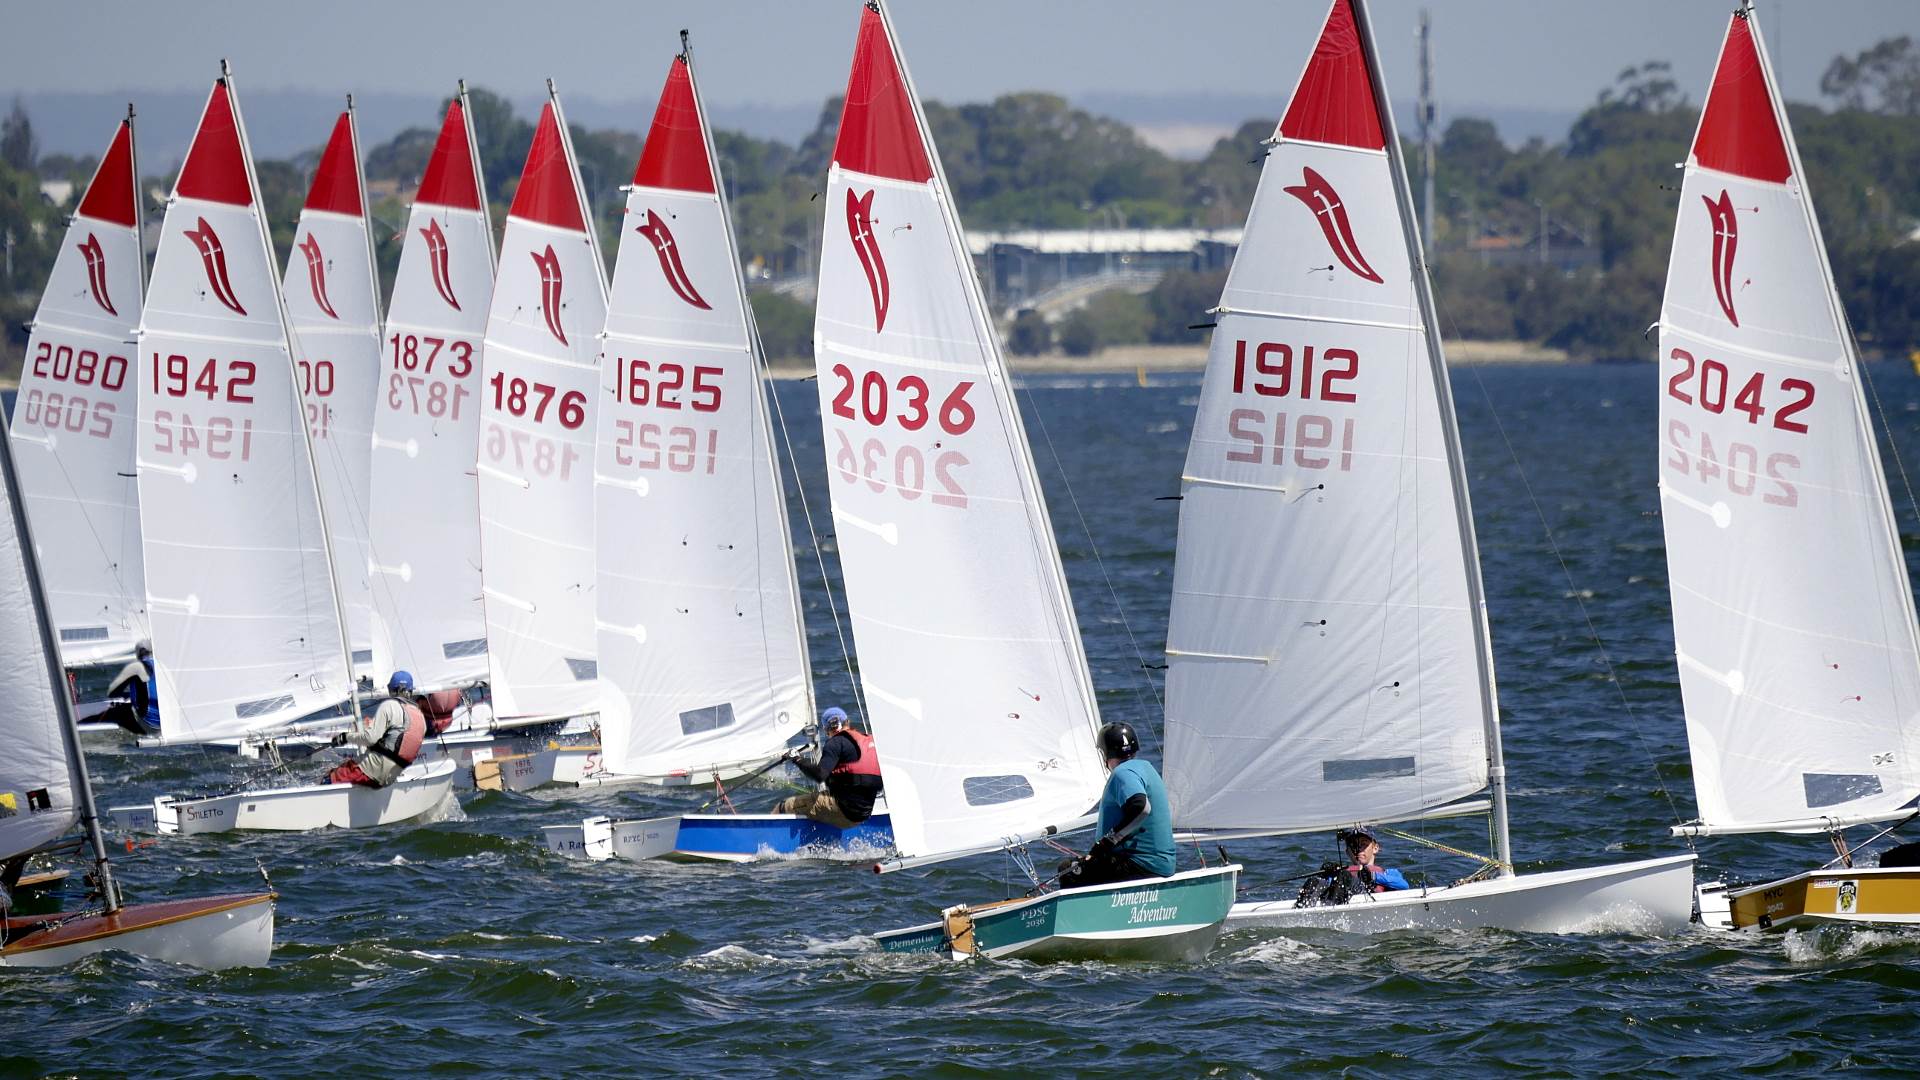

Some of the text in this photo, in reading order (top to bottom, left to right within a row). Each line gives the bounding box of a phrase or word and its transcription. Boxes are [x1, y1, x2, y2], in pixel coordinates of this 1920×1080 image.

[33, 342, 128, 392] 2080
[152, 352, 256, 404] 1942
[390, 333, 473, 379] 1873
[1233, 340, 1359, 403] 1912
[490, 371, 587, 430] 1876
[616, 357, 723, 412] 1625
[832, 363, 976, 436] 2036
[1668, 347, 1815, 434] 2042
[1020, 904, 1050, 921] PDSC
[1026, 917, 1046, 928] 2036
[1111, 889, 1159, 908] Dementia
[1128, 903, 1178, 924] Adventure
[888, 935, 934, 950] Dementia
